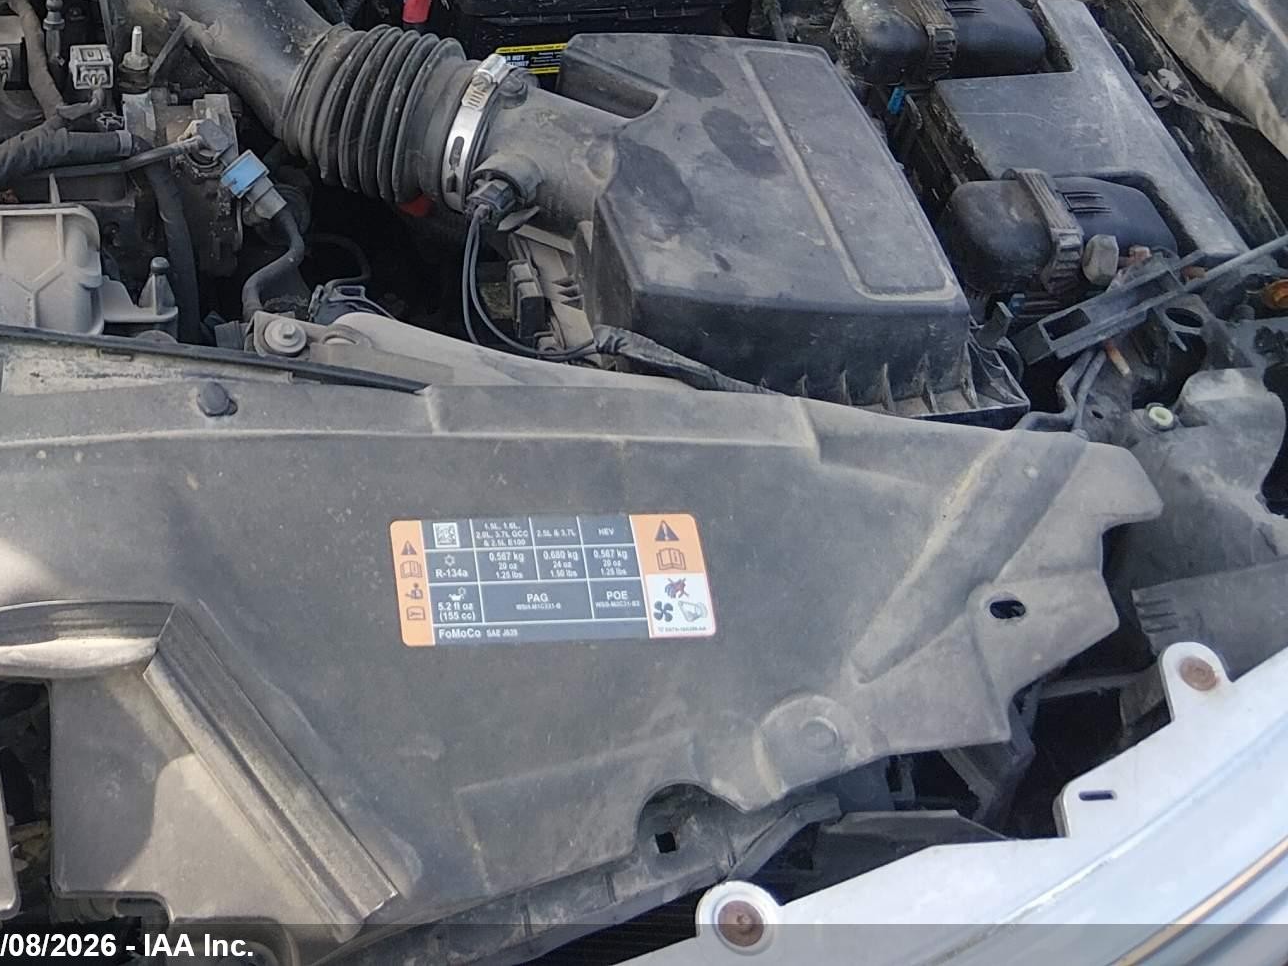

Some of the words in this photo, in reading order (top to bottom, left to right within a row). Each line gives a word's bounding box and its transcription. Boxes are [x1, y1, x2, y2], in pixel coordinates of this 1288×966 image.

[488, 551, 511, 562] 0.567
[512, 551, 524, 563] kg
[567, 549, 579, 561] kg
[616, 548, 628, 561] kg
[498, 562, 507, 570] 20
[552, 560, 562, 569] 24
[434, 568, 469, 578] R-134a
[511, 570, 524, 579] lbs
[566, 569, 578, 577] lbs
[615, 568, 627, 576] lbs
[526, 592, 549, 603] PAG
[606, 590, 629, 600] POE
[437, 601, 452, 611] 5.2
[453, 601, 461, 611] fl
[462, 602, 474, 611] oz
[439, 612, 460, 622] (155
[461, 611, 476, 622] cc)
[438, 628, 482, 639] FoMoCo
[486, 628, 501, 637] SAE
